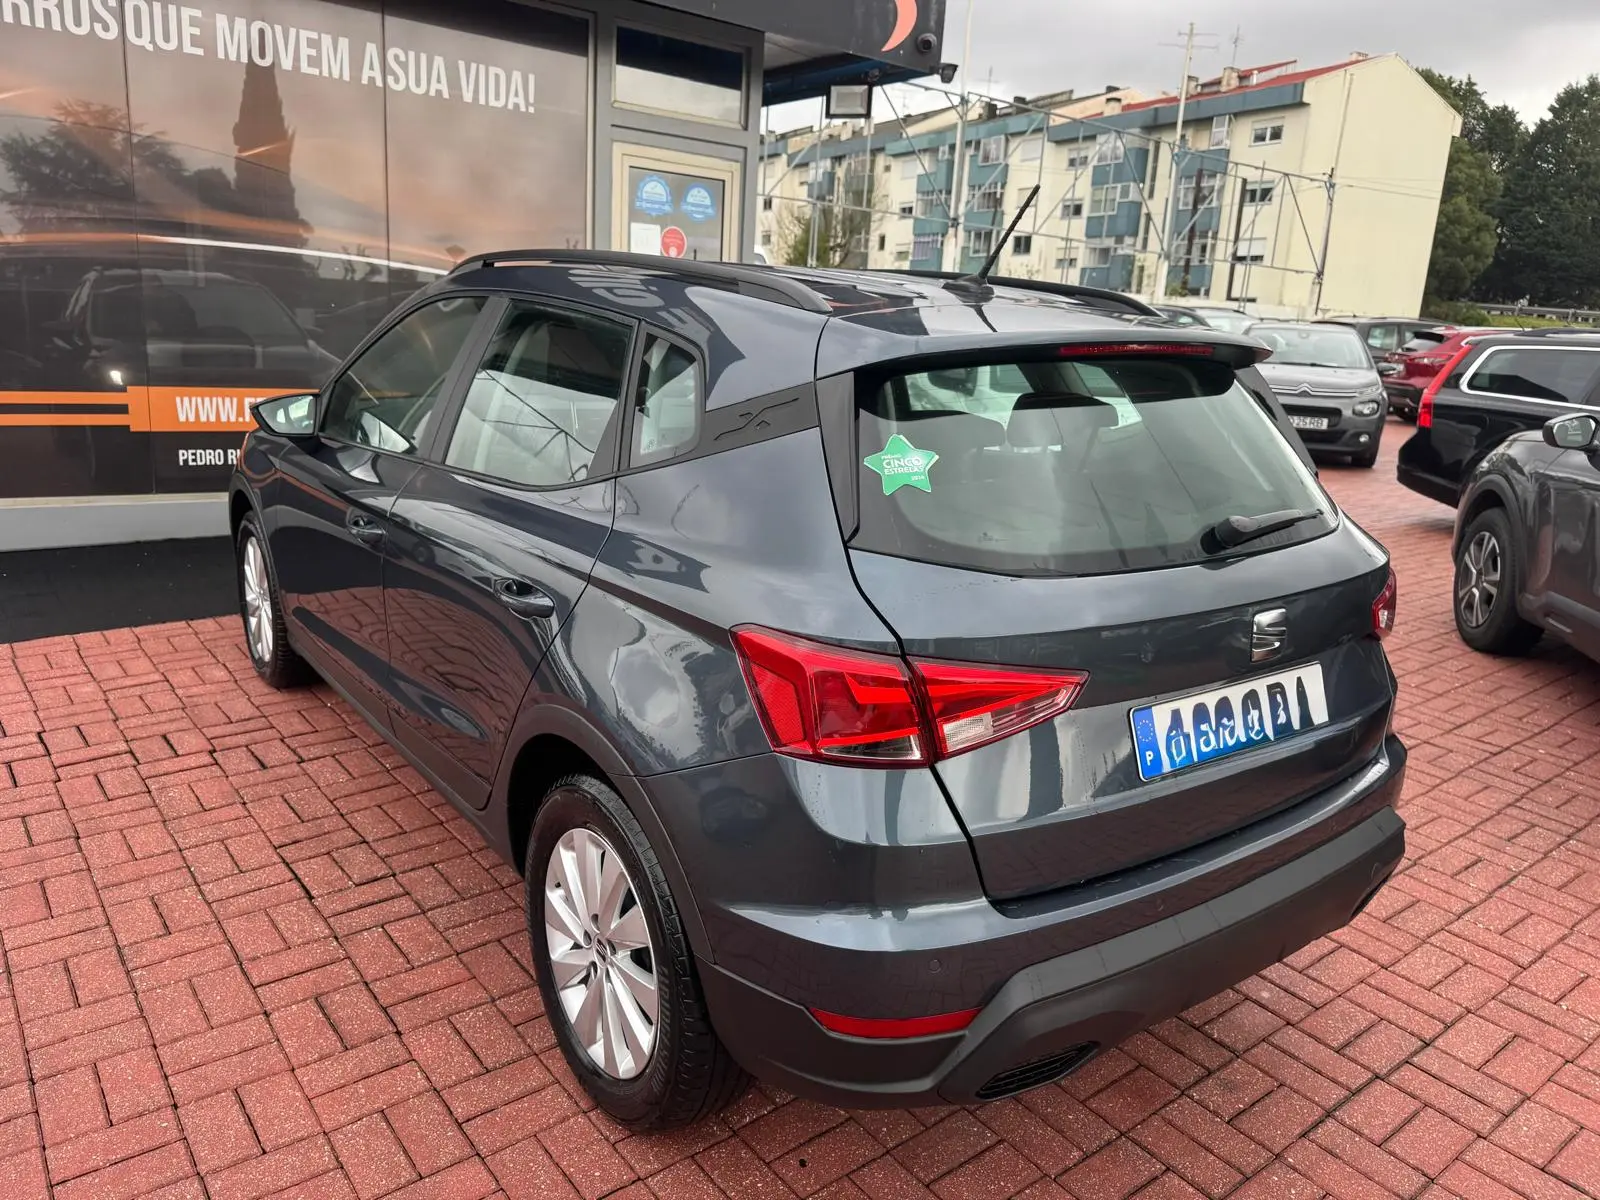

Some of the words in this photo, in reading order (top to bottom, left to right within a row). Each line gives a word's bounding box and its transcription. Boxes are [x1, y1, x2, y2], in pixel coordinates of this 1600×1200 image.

[125, 0, 205, 56] QUE
[216, 13, 350, 82] MOVEM
[361, 42, 383, 87] A
[386, 47, 450, 99] SUA
[458, 60, 535, 113] VIDA!
[178, 448, 225, 466] PEDRO
[882, 457, 922, 468] CINCO
